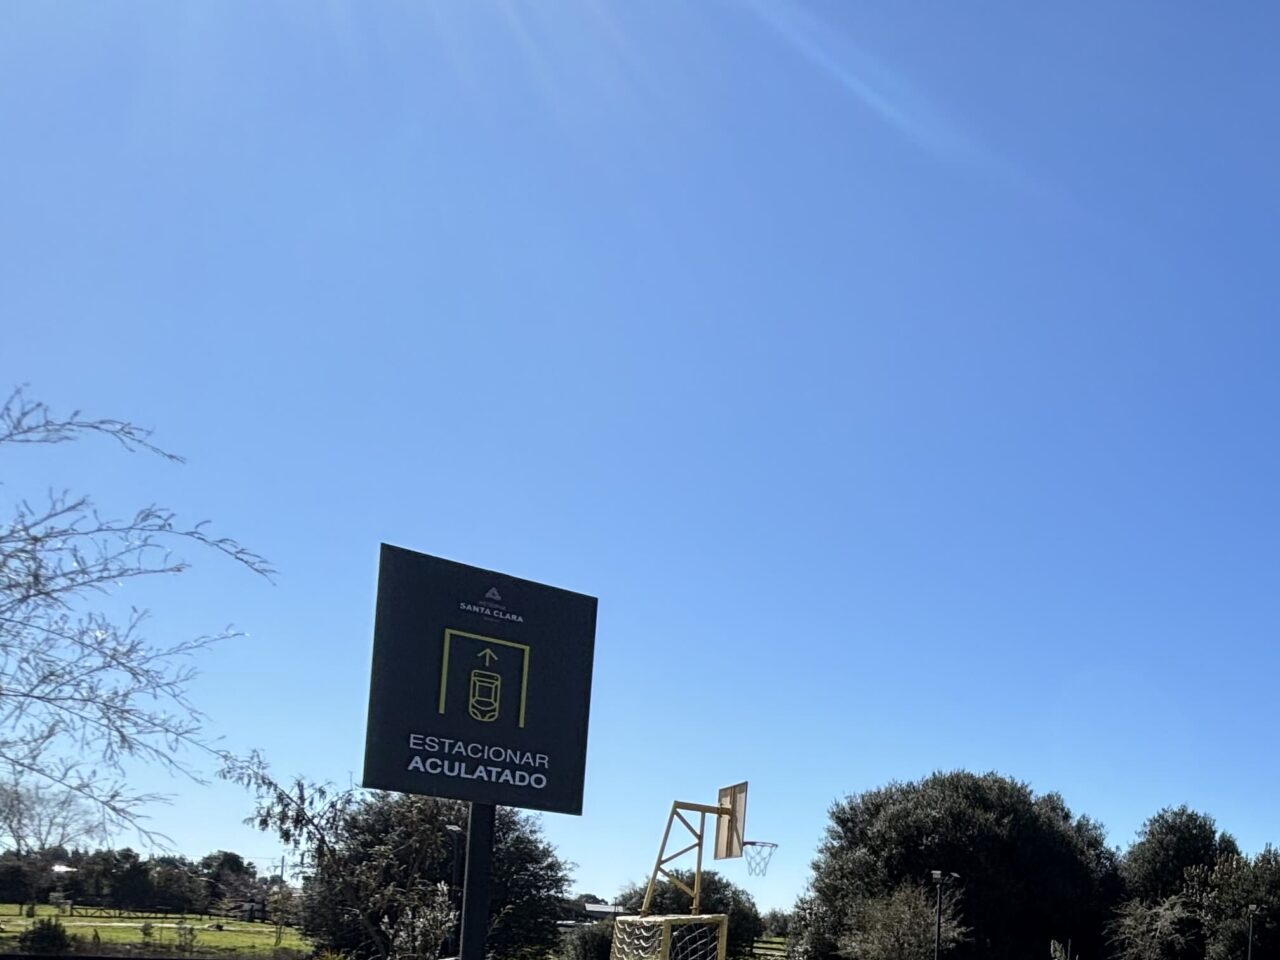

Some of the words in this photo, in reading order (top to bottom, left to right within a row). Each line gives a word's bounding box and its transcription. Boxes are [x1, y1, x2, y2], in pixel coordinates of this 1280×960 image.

[460, 602, 491, 615] SANTA
[493, 610, 524, 623] CLARA
[409, 733, 549, 768] ESTACIONAR
[408, 756, 547, 789] ACULATADO
